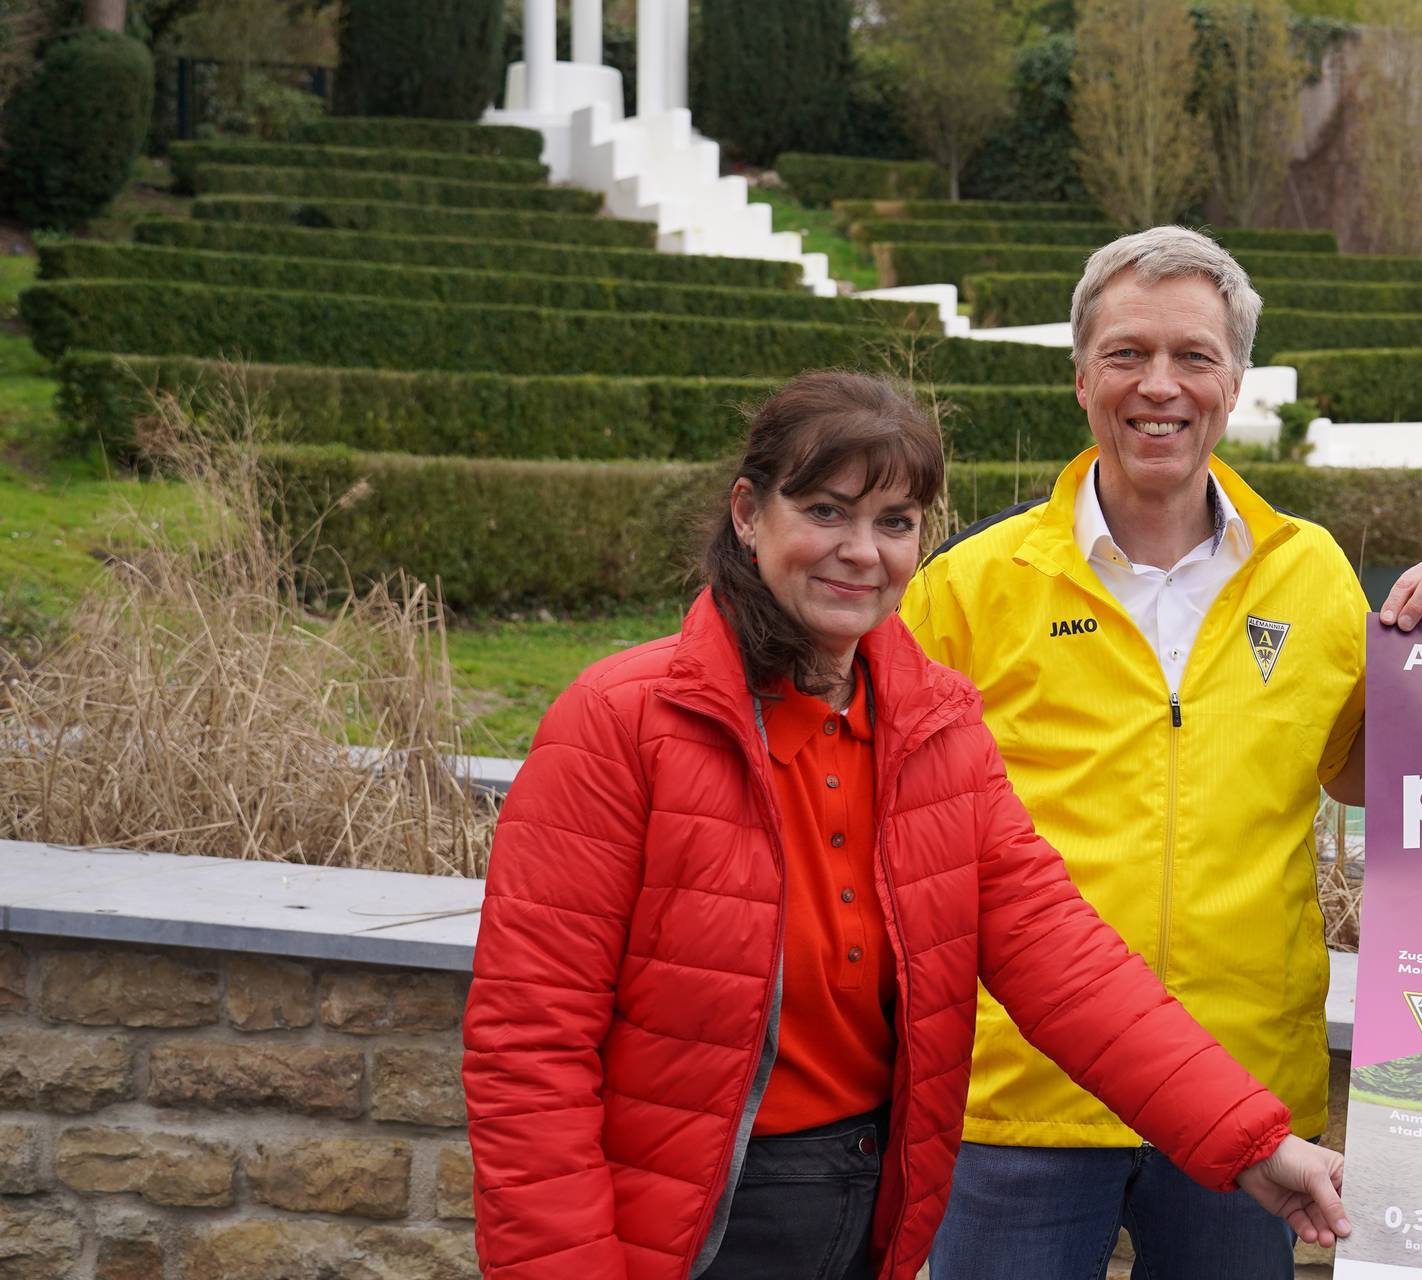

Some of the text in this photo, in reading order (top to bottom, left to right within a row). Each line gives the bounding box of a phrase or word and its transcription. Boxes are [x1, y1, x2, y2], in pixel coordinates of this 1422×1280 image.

[1050, 618, 1098, 637] JAKO
[1248, 618, 1286, 631] ALEMANNIA
[1258, 630, 1273, 647] A
